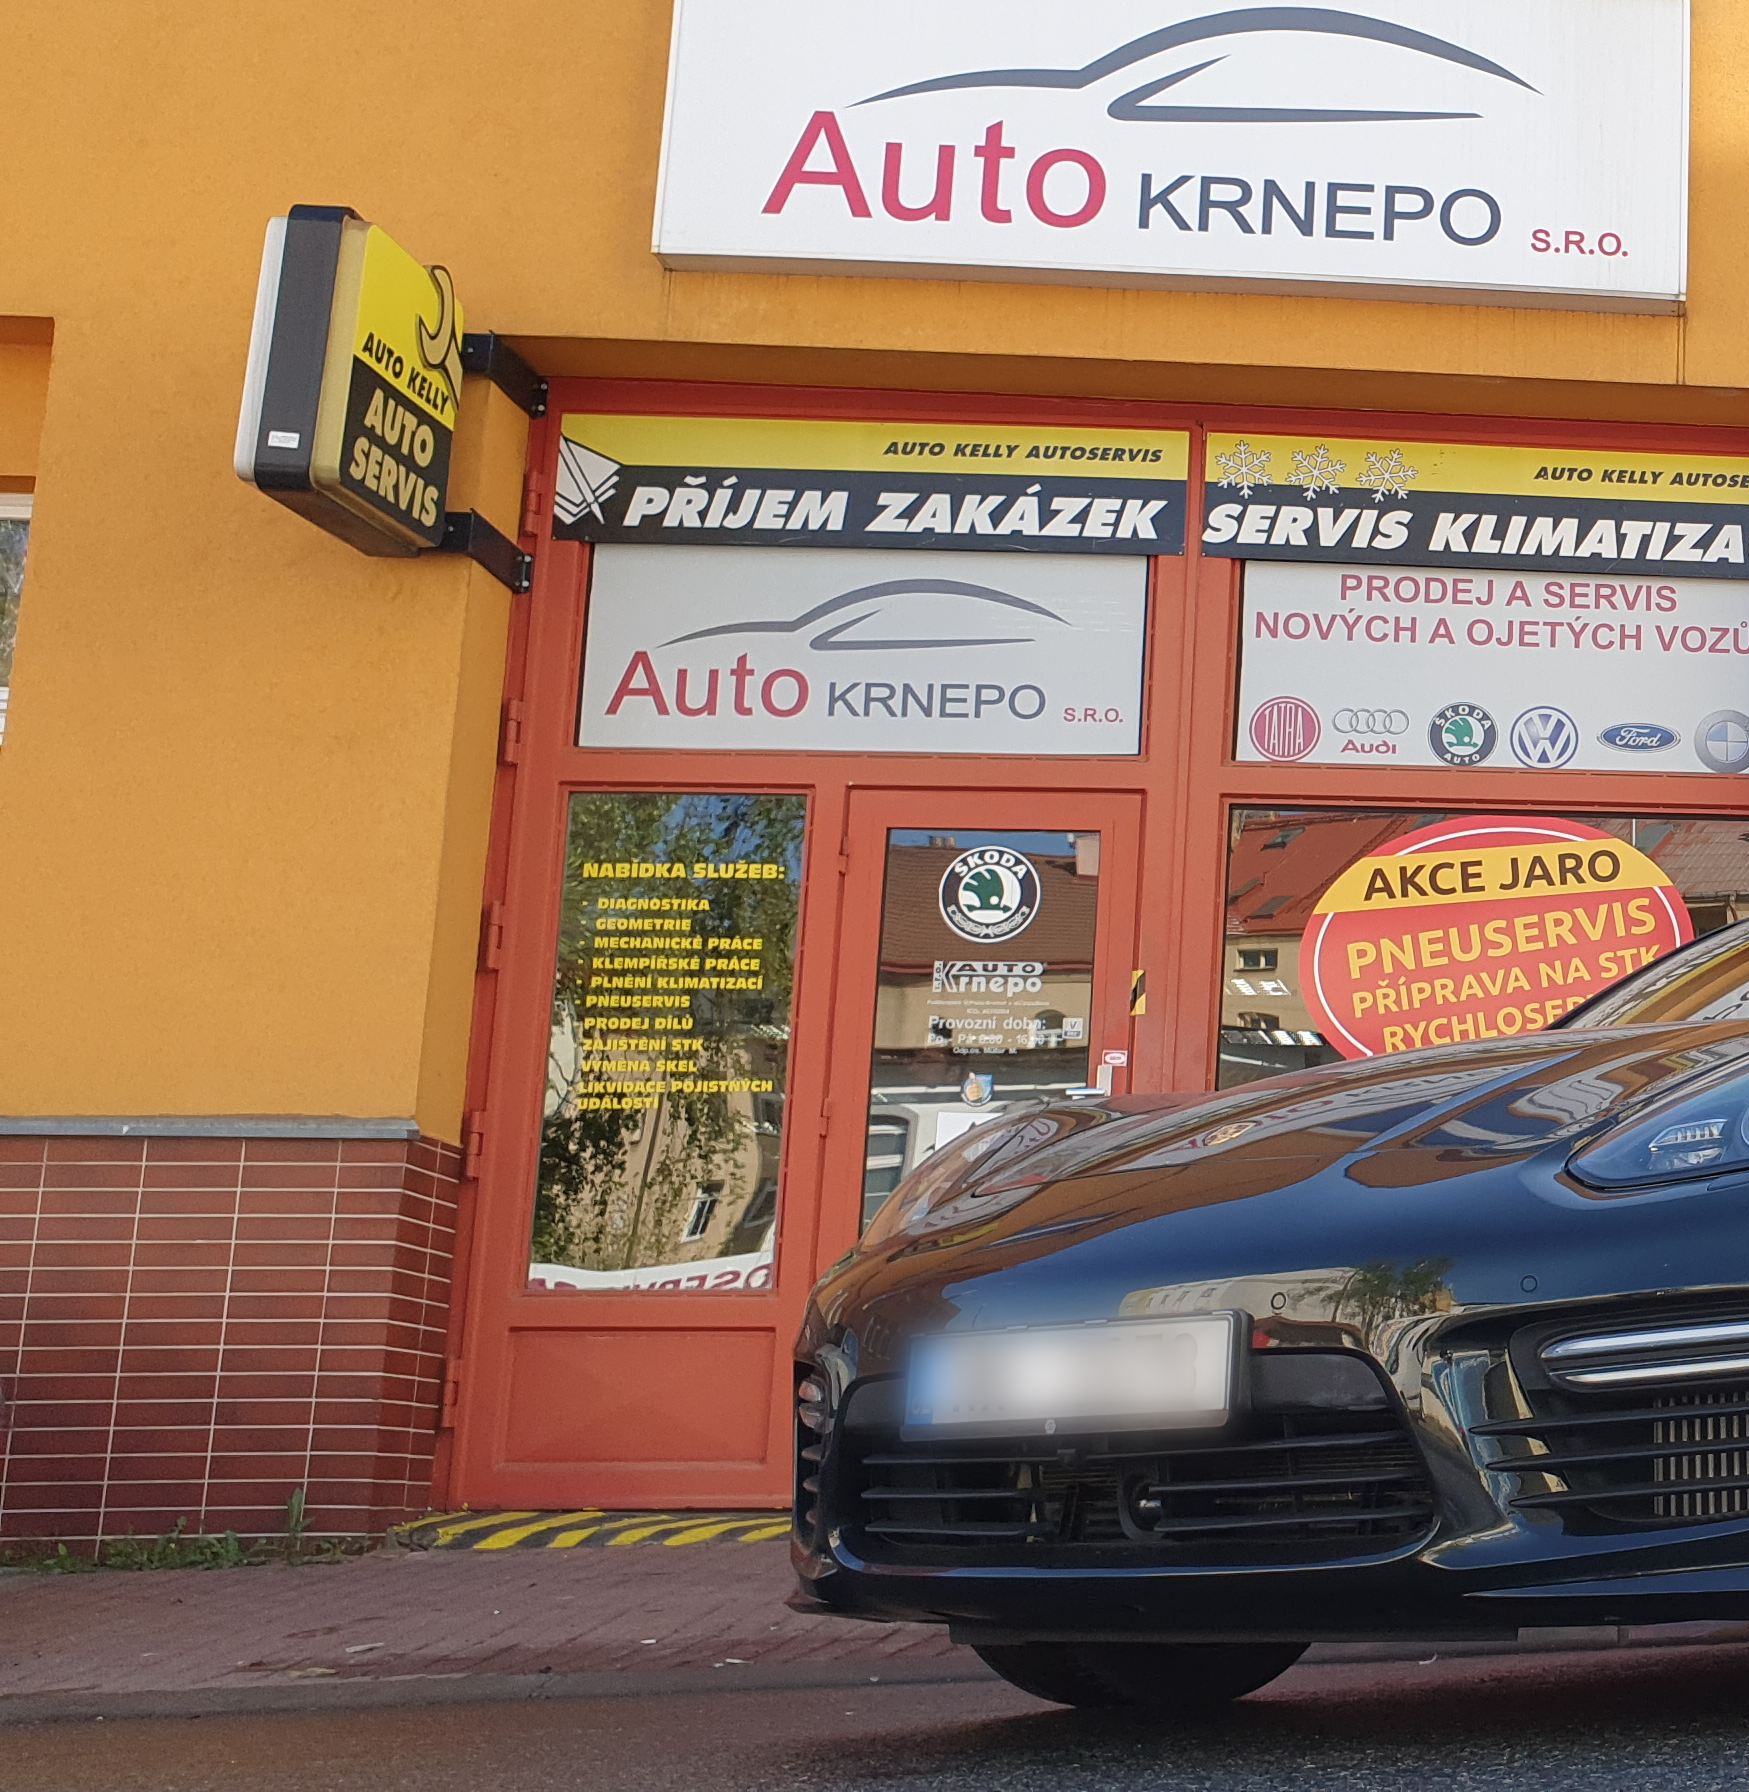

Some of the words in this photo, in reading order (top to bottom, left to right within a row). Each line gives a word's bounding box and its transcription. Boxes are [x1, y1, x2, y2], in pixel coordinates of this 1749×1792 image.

[760, 109, 1107, 229] Auto
[1138, 172, 1502, 247] KRNEPO
[1530, 228, 1629, 258] S.R.O.
[362, 332, 404, 380] AUTO
[407, 365, 450, 416] KELLY
[363, 387, 435, 468] AUTO
[883, 441, 945, 457] AUTO
[953, 442, 1020, 459] KELLY
[1025, 445, 1164, 464] AUTOSERVIS
[349, 436, 440, 528] SERVIS
[1534, 465, 1594, 483] AUTO
[1601, 468, 1665, 486] KELLY
[622, 475, 850, 531] PŘÍJEM
[864, 484, 1170, 541] ZAKÁZEK
[1201, 502, 1412, 550] SERVIS
[1340, 574, 1494, 607] PRODEJ
[1506, 582, 1533, 608] A
[1543, 583, 1678, 613] SERVIS
[1254, 607, 1418, 645] NOVÝCH
[1428, 618, 1456, 646] A
[1466, 616, 1642, 651] OJETÝCH
[605, 650, 811, 718] Auto
[826, 681, 1046, 720] KRNEPO
[1063, 706, 1124, 724] S.R.O.
[1264, 703, 1304, 757] TATRA
[1616, 727, 1662, 747] Ford
[1341, 739, 1397, 755] Audi
[1443, 753, 1481, 764] AUTO
[582, 860, 687, 879] NABÍDKA
[693, 859, 786, 880] SLUŽEB:
[1363, 858, 1486, 902] AKCE
[1498, 849, 1621, 892] JARO
[598, 898, 710, 911] DIAGNOSTIKA
[595, 918, 692, 931] GEOMETRIE
[594, 935, 703, 949] MECHANICKÉ
[708, 935, 763, 950] PRÁCE
[1346, 897, 1657, 980] PNEUSERVIS
[705, 956, 761, 971] PRÁCE
[956, 963, 1036, 974] AUTO
[657, 976, 763, 990] KLIMATIZACÍ
[1351, 966, 1532, 1018] PŘÍPRAVA
[1537, 958, 1592, 988] NA
[1599, 944, 1661, 979] STK
[586, 995, 691, 1008] PNEUSERVIS
[584, 1017, 650, 1030] PRODEJ
[672, 1038, 704, 1051] STK
[656, 1060, 698, 1072] SKEL
[578, 1081, 666, 1093] LIKVIDACE
